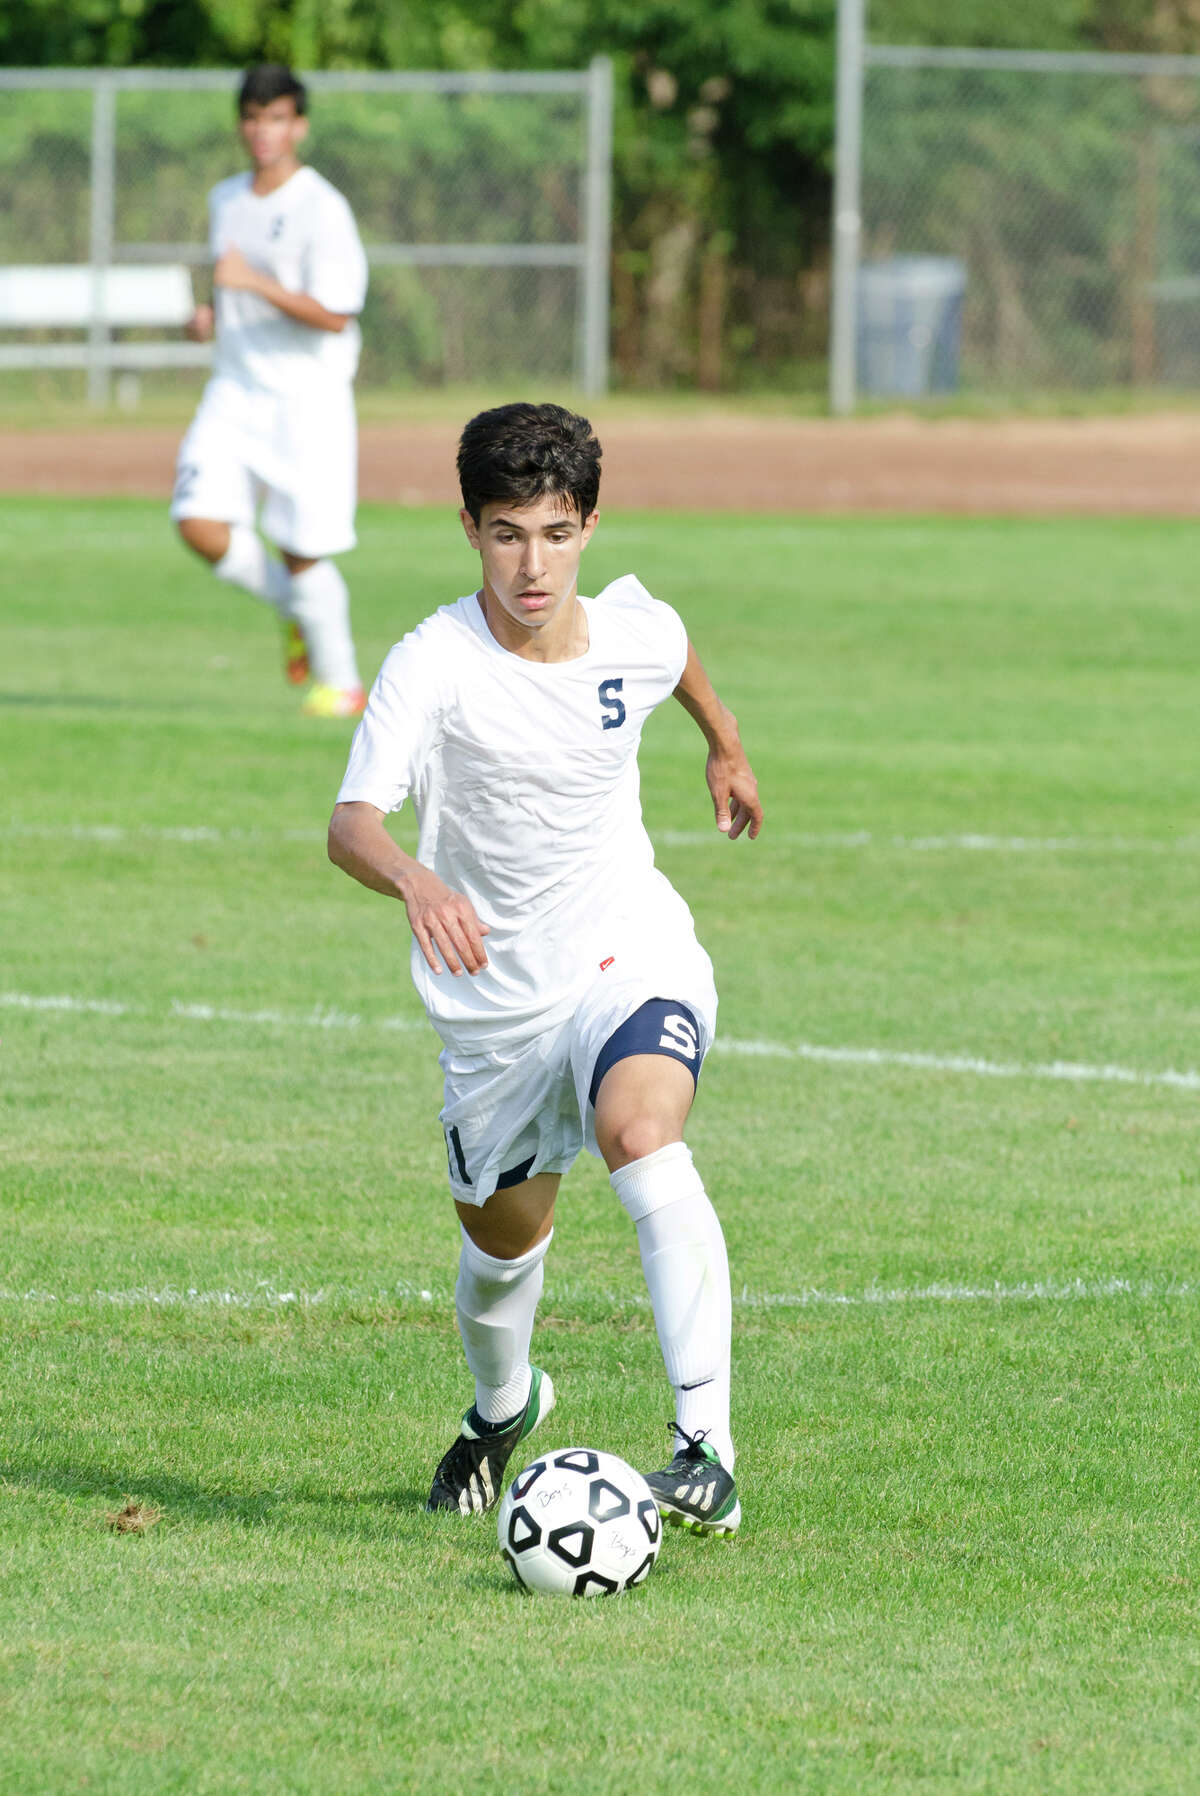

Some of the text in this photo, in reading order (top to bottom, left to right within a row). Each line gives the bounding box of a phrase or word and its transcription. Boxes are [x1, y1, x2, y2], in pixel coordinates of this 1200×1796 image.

[598, 678, 626, 730] S
[659, 1014, 697, 1060] S
[537, 1482, 573, 1508] Boys
